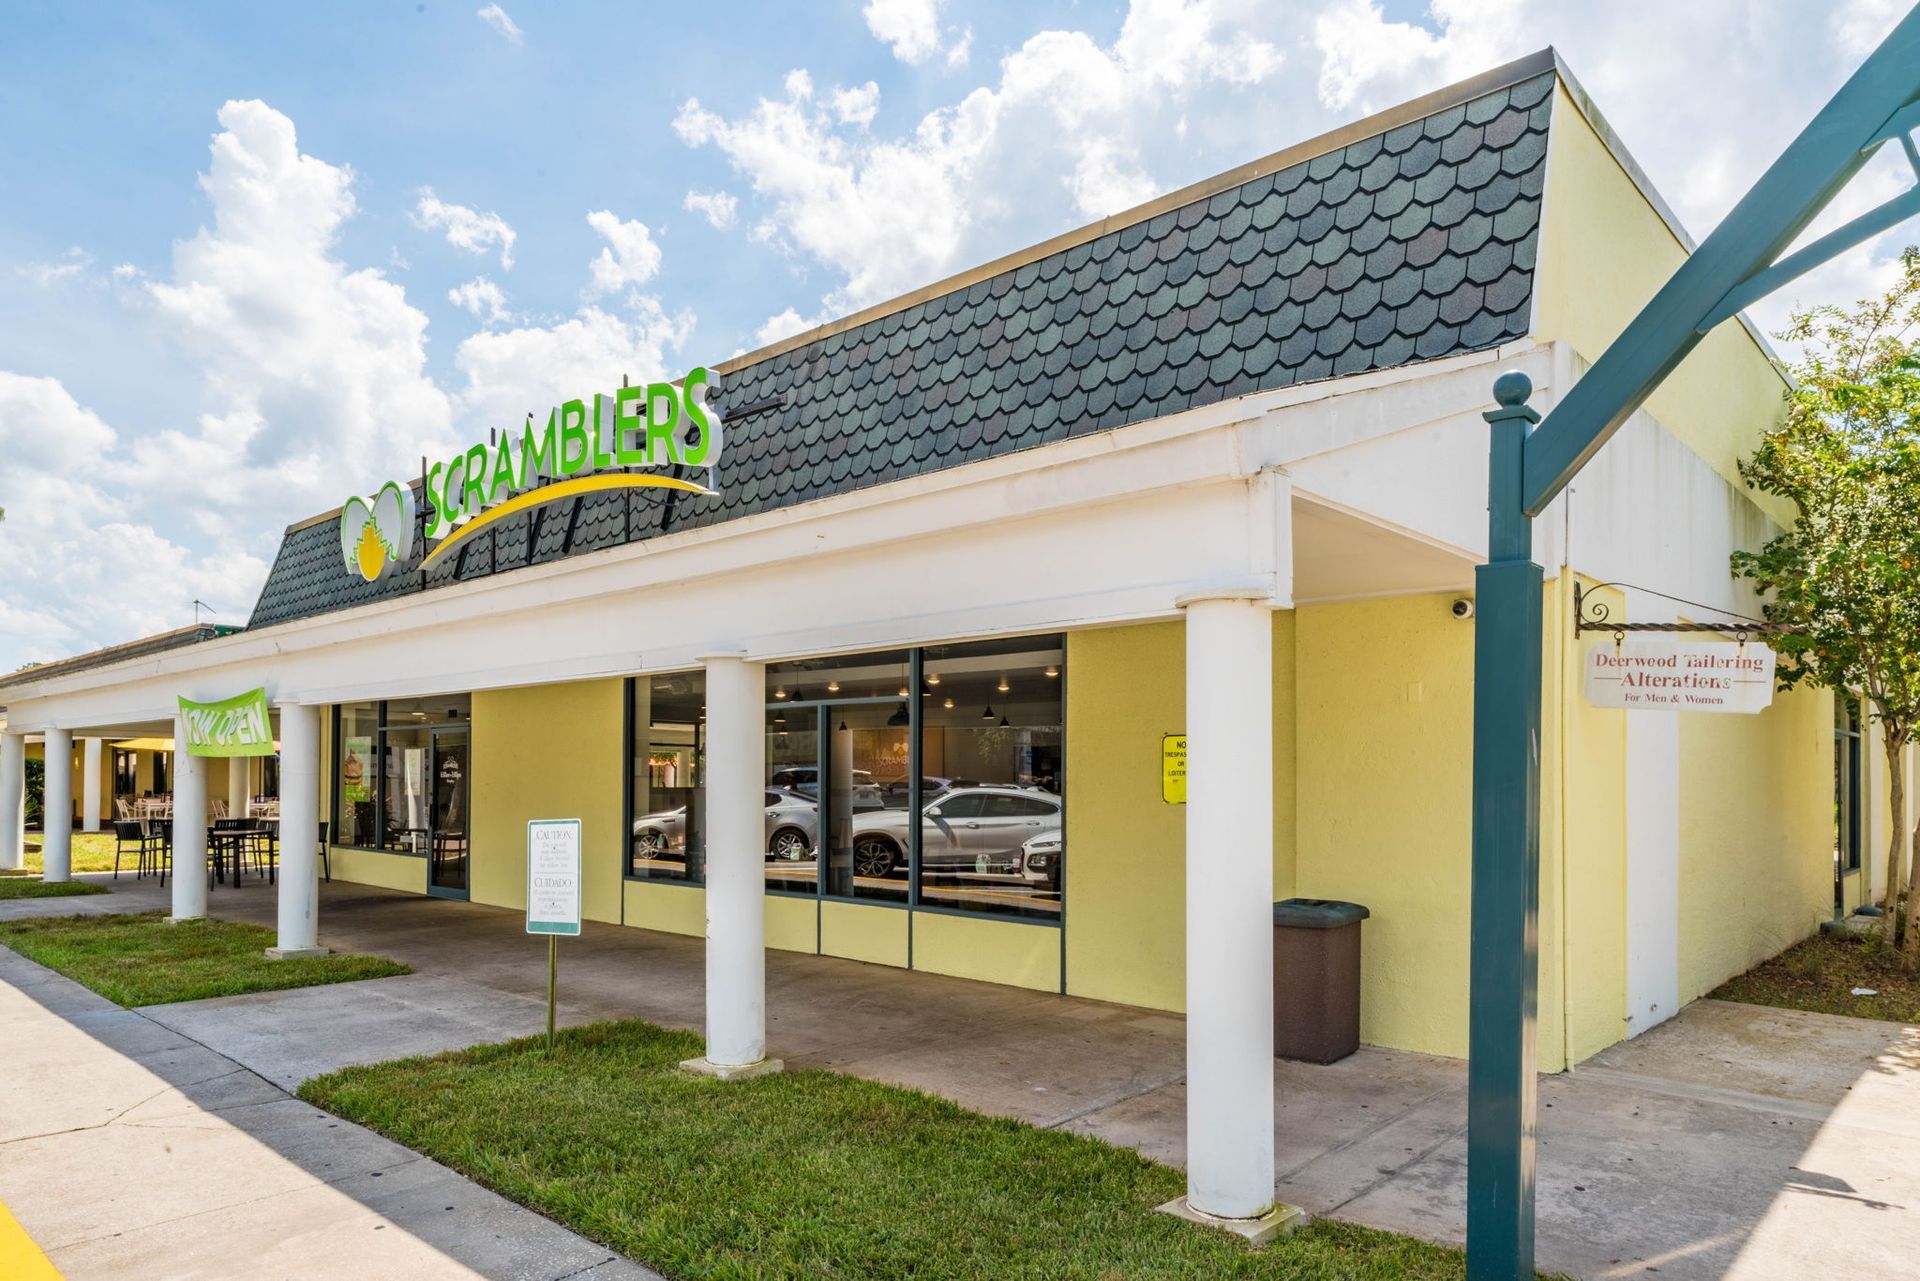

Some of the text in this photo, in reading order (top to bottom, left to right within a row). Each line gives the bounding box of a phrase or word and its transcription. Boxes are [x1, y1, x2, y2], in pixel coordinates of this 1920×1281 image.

[425, 366, 719, 539] SCRAMBLERS
[1595, 653, 1764, 673] Deerwood Tailoring
[1620, 672, 1732, 689] Alterations
[1624, 692, 1724, 705] For Men & Women
[181, 701, 268, 747] NOW OPEN
[1177, 741, 1187, 749] NO
